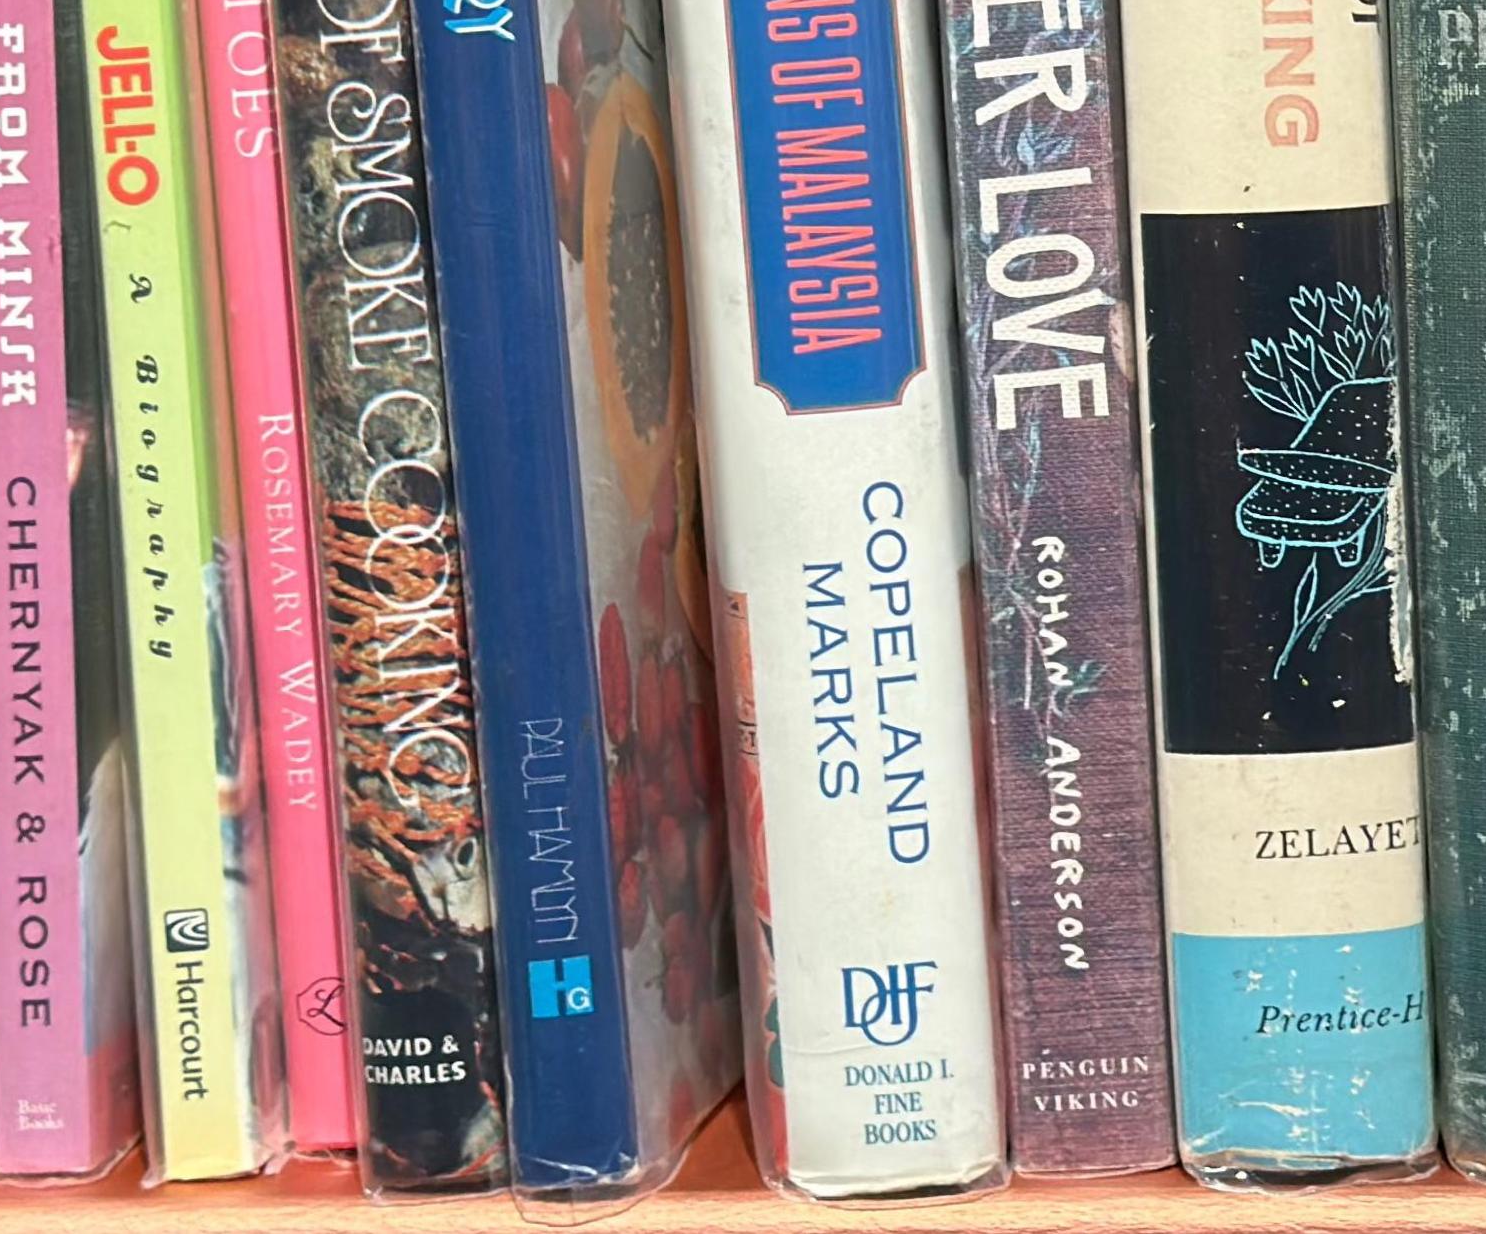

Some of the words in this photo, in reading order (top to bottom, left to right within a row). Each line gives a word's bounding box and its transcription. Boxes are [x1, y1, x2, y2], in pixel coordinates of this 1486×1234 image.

[96, 25, 160, 206] JELL-O
[770, 58, 863, 107] OF
[325, 78, 435, 372] SMOKE
[772, 129, 882, 356] MALAYSIA
[981, 166, 1108, 430] LOVE
[135, 355, 174, 659] Biography
[6, 475, 46, 786] CHERNYAK
[358, 387, 473, 810] COOKING
[1032, 536, 1067, 683] ROHAN
[802, 561, 860, 800] MARKS
[861, 480, 930, 865] COPELAND
[14, 811, 46, 846] &
[518, 717, 566, 800] PAUL
[526, 806, 578, 943] HAMLYN
[1045, 737, 1090, 970] ANDERSON
[17, 874, 52, 1029] ROSE
[174, 959, 206, 1102] Harcourt
[362, 1036, 433, 1056] DAVID
[441, 1034, 460, 1055] &
[363, 1060, 467, 1086] CHARLES
[844, 1061, 933, 1086] DONALD
[940, 1059, 955, 1079] I.
[874, 1091, 923, 1114] FINE
[1021, 1054, 1151, 1082] PENGUIN
[1033, 1088, 1140, 1113] VIKING
[864, 1119, 936, 1145] BOOKS
